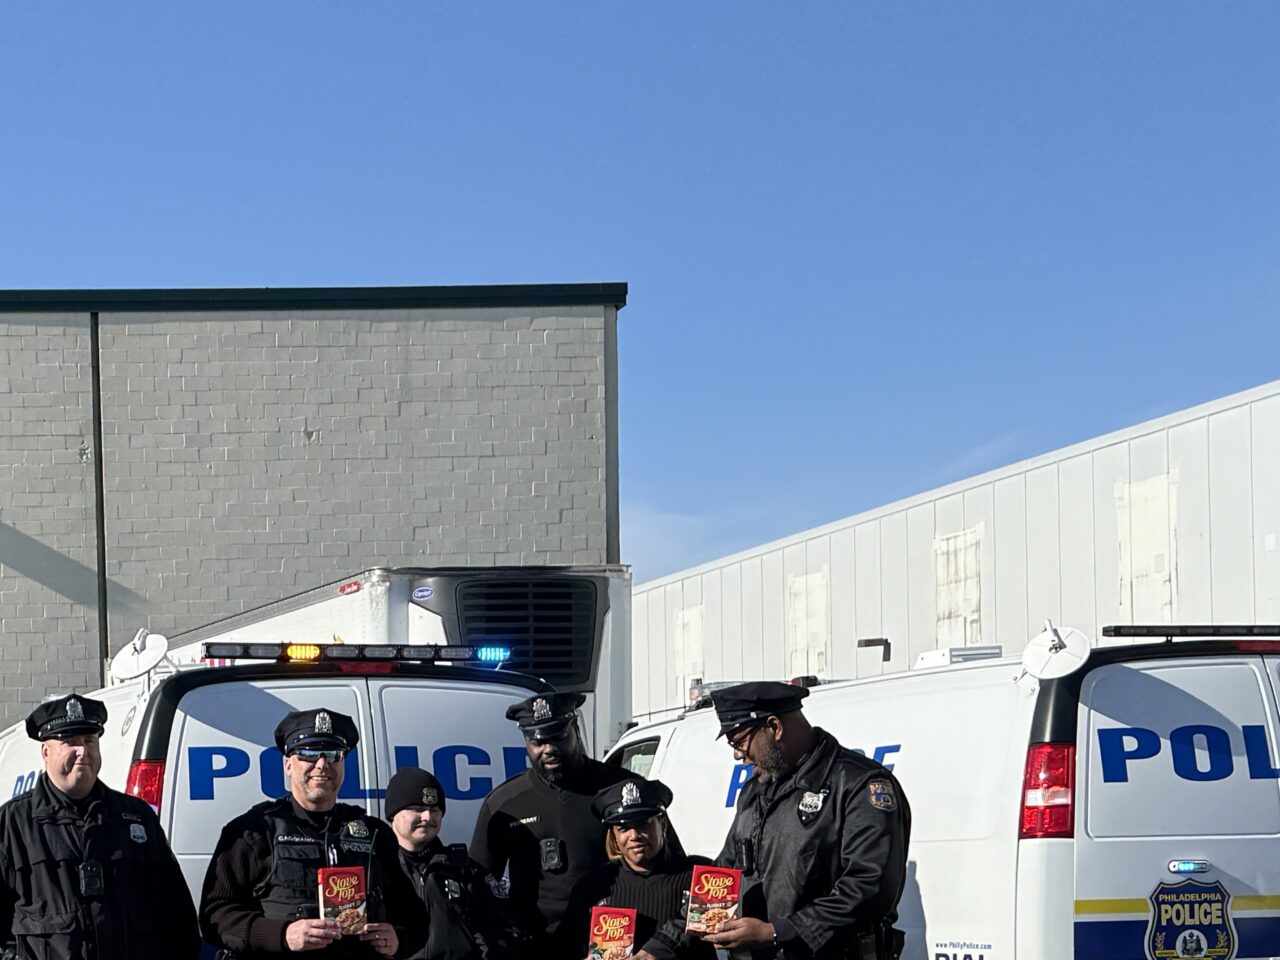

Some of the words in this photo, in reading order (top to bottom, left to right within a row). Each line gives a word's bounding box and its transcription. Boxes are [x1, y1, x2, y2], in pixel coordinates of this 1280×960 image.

[325, 875, 359, 898] Stove
[695, 874, 734, 894] Stove
[338, 887, 355, 902] Top
[707, 887, 727, 900] Top
[1158, 892, 1222, 902] PHILADELPHIA
[1160, 902, 1223, 926] POLICE
[594, 914, 630, 935] Stove
[606, 927, 625, 941] Top
[935, 942, 992, 950] www.PhillyPolice.com
